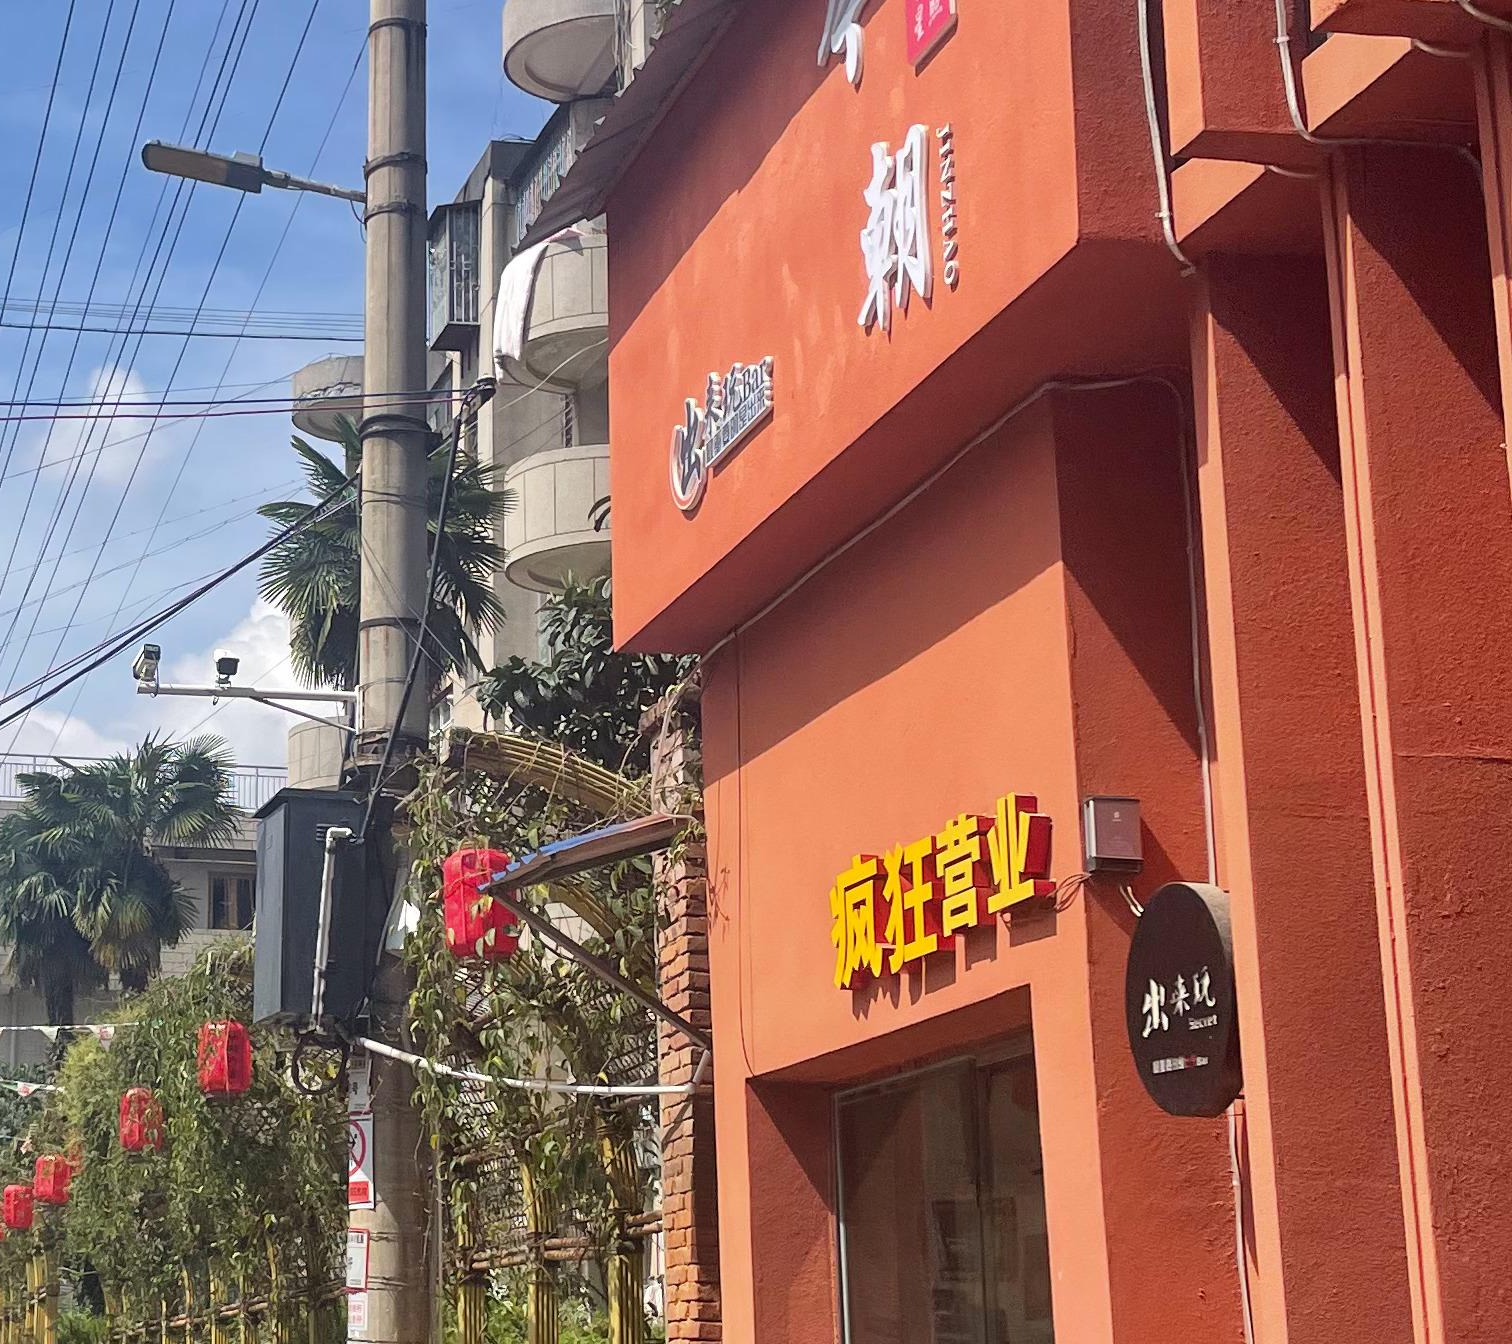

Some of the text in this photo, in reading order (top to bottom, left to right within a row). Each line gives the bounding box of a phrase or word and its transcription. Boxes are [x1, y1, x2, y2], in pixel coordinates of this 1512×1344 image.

[829, 792, 1037, 989] 疯狂营业
[1142, 965, 1216, 1038] 出来玩
